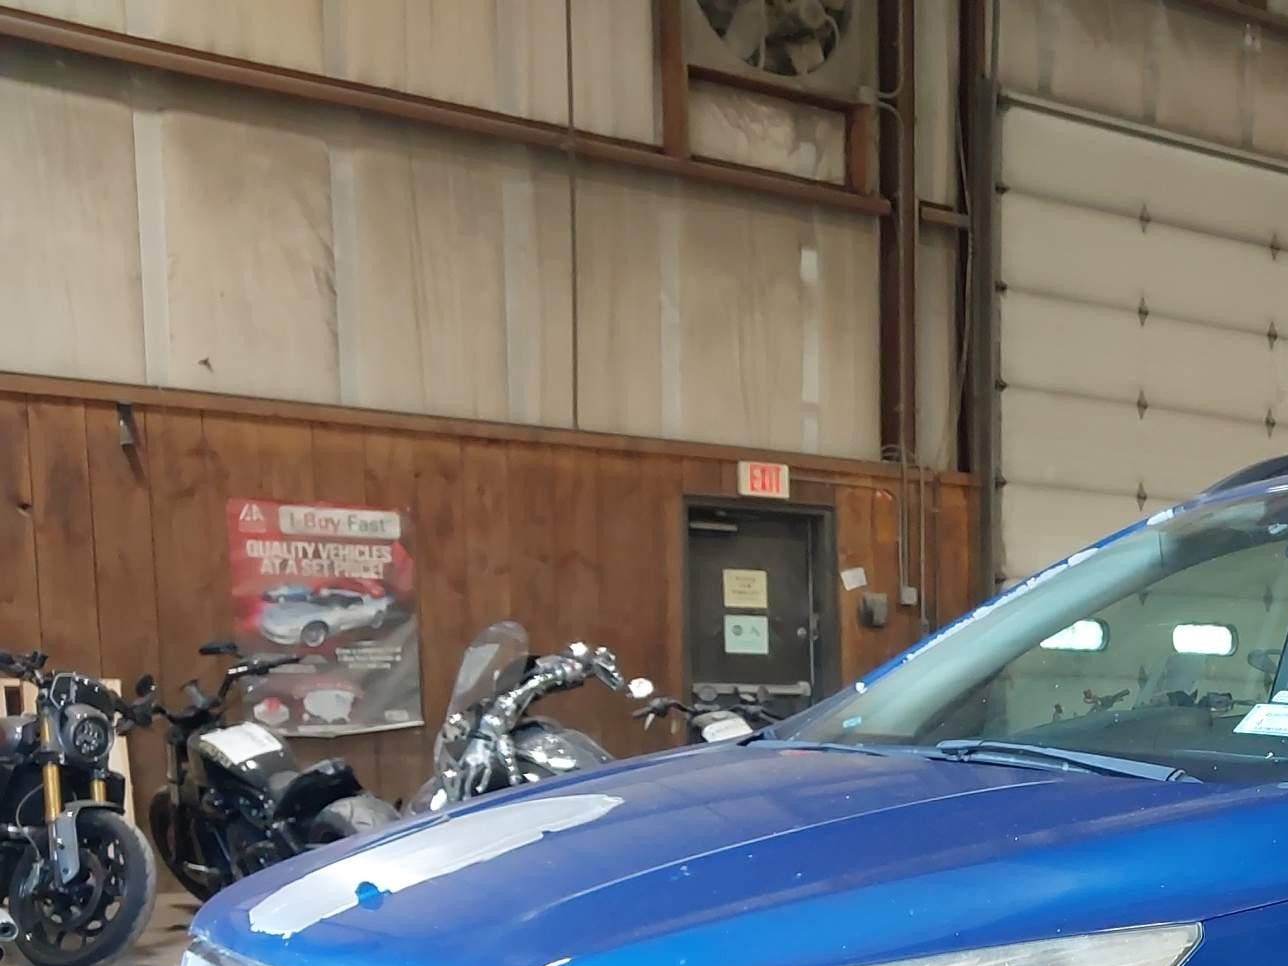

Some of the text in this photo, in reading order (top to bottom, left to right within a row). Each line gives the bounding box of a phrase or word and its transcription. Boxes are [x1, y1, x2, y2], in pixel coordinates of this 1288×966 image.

[347, 514, 386, 532] Fast
[246, 539, 393, 563] QUALITY VEHICLES
[260, 558, 283, 576] AT
[285, 559, 298, 576] A
[301, 558, 331, 578] SET
